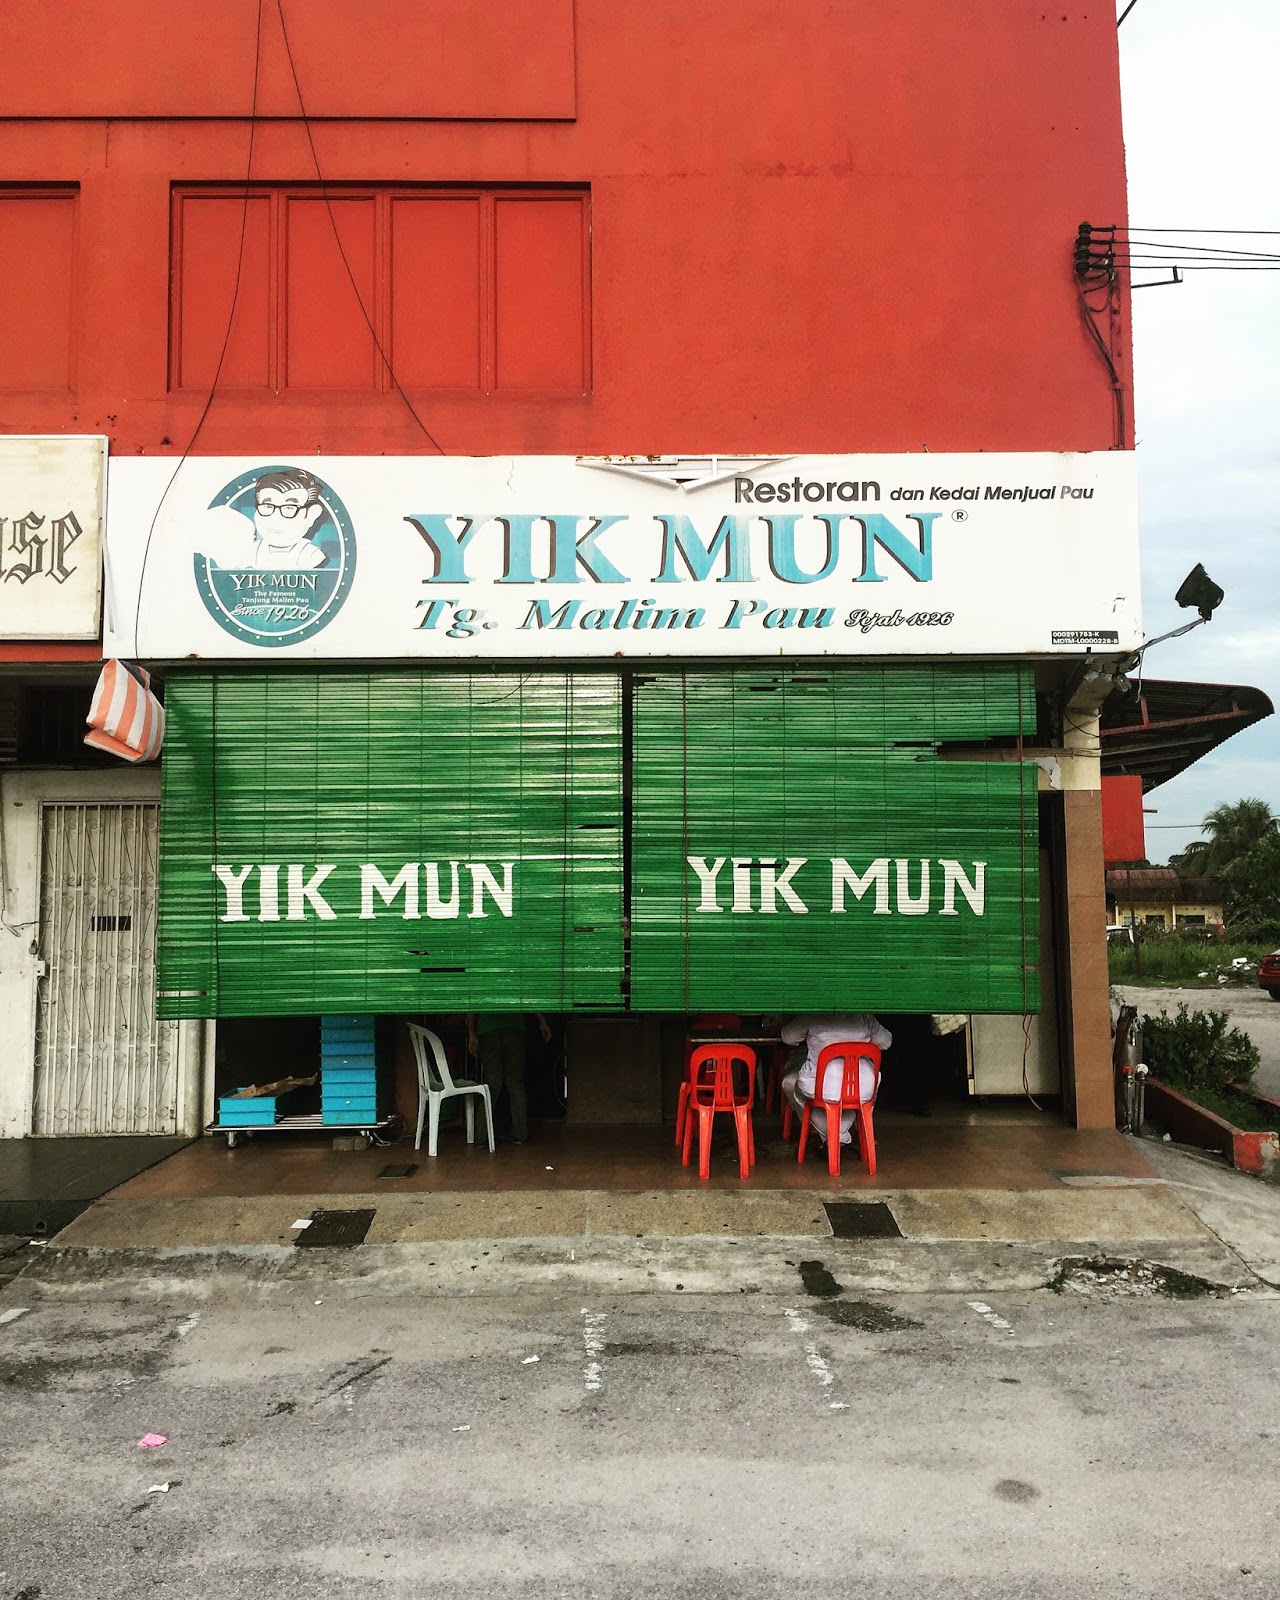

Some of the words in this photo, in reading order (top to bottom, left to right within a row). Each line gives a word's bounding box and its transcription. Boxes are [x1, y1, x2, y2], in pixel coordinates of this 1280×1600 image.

[735, 477, 881, 503] Restoran
[890, 487, 925, 500] dan
[929, 486, 980, 500] Kedai
[984, 486, 1056, 502] Menjual
[1060, 486, 1094, 499] Pau
[404, 514, 632, 584] YIK
[650, 512, 942, 584] MUN
[229, 574, 267, 591] YIK
[271, 574, 318, 590] MUN
[232, 604, 265, 616] Since
[265, 605, 309, 623] 1926
[413, 599, 498, 638] Tg.
[515, 598, 706, 630] Malim
[718, 599, 837, 630] Pau
[844, 609, 905, 633] Sejak
[906, 612, 955, 626] 1926
[211, 863, 338, 922] YIK
[358, 861, 516, 920] MUN
[686, 856, 809, 915] YIK
[830, 856, 988, 916] MUN
